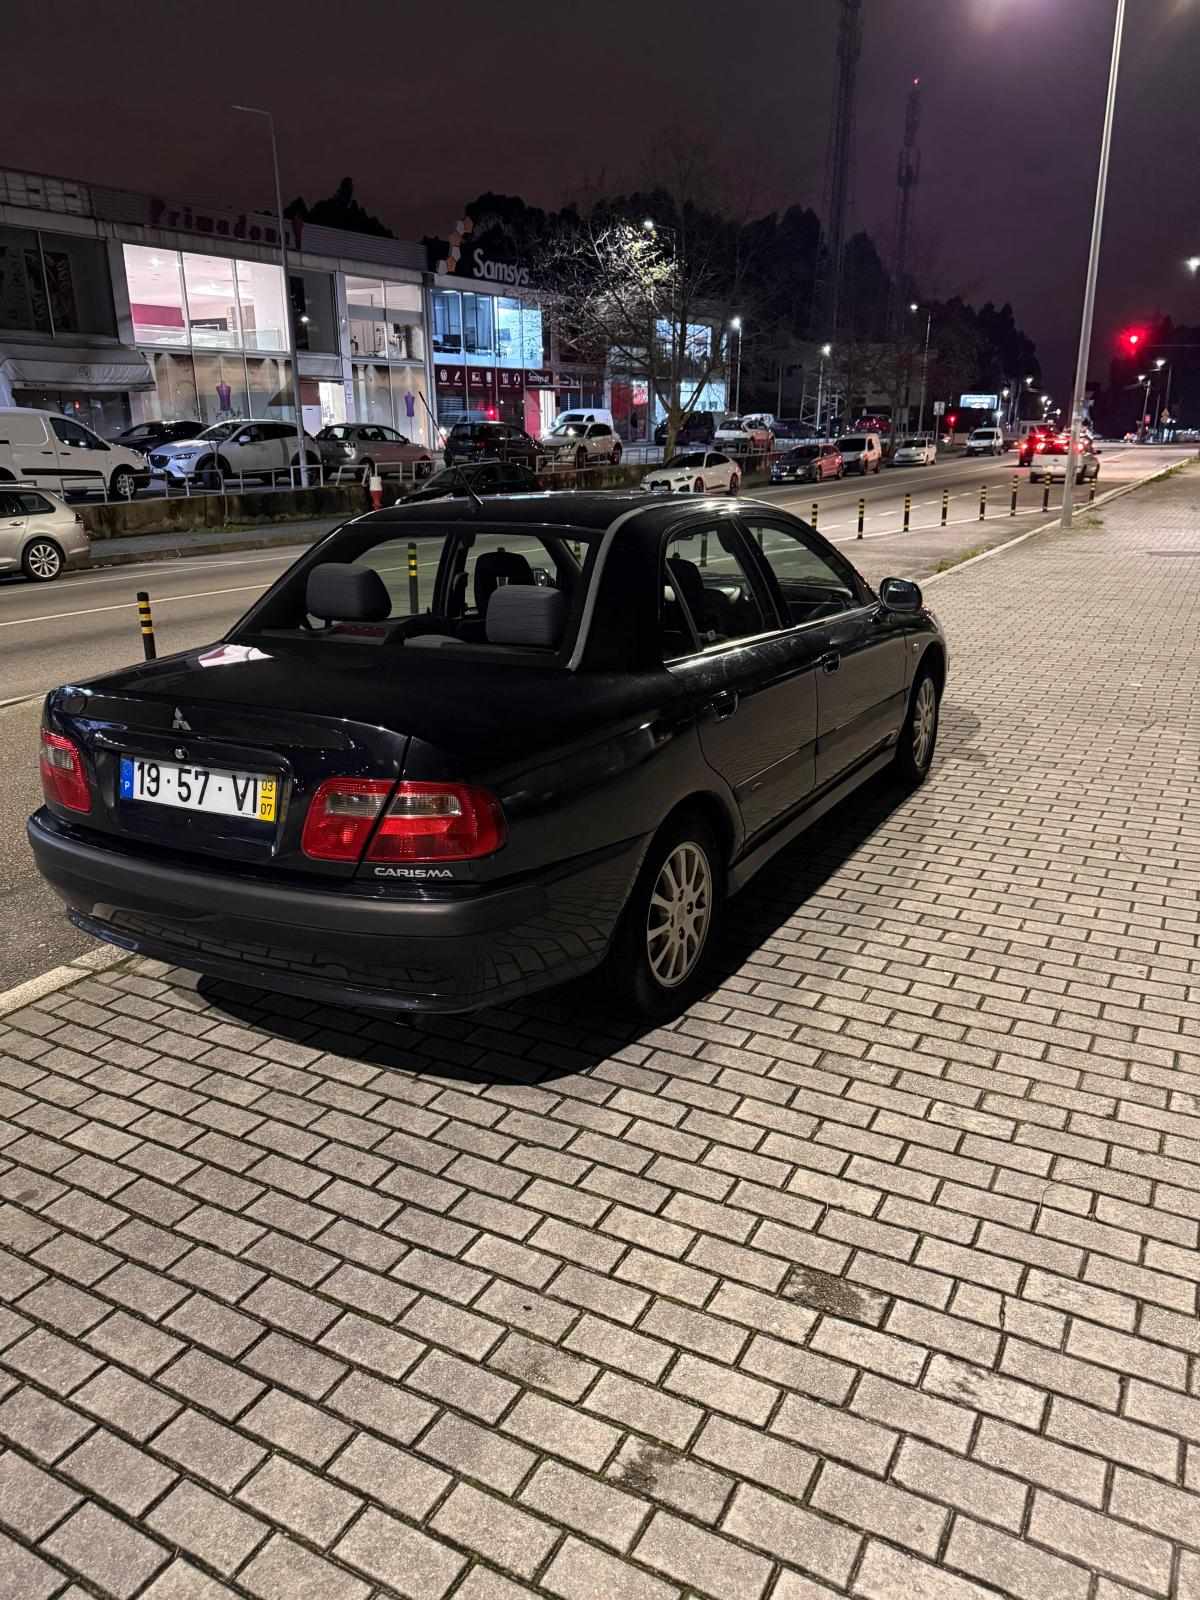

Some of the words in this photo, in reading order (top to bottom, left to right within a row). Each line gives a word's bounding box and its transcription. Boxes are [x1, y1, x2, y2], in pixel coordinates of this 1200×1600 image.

[472, 247, 530, 286] Samsys
[124, 780, 130, 791] P
[261, 778, 273, 792] 03
[260, 803, 273, 816] 07
[374, 867, 454, 878] CARISMA
